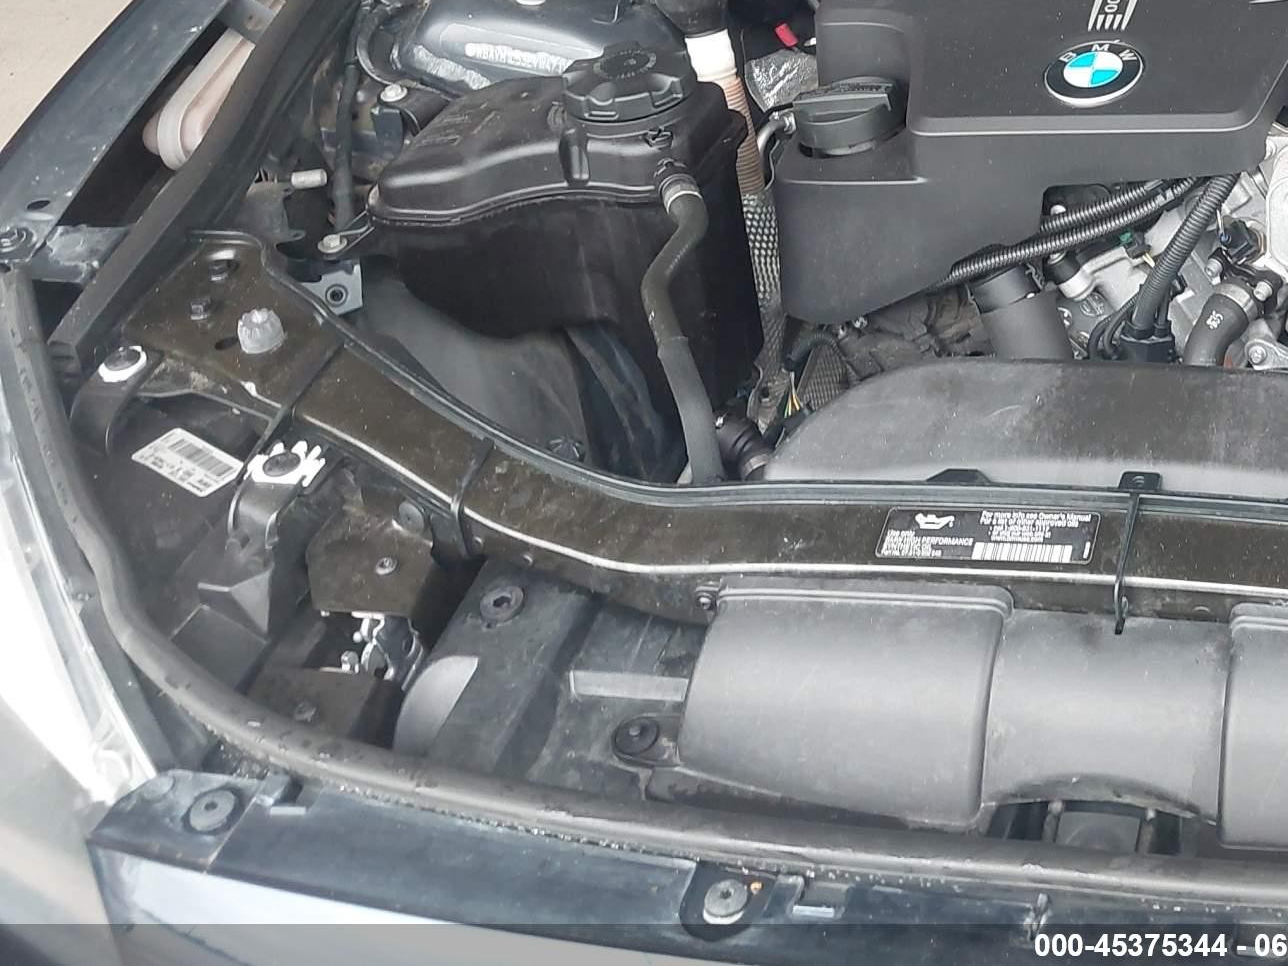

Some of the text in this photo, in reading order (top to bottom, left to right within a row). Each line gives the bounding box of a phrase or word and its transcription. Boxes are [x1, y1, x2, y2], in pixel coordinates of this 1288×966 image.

[1058, 43, 1138, 63] BMW
[1039, 512, 1066, 521] Owner's
[1067, 513, 1091, 522] Manual
[922, 537, 974, 546] PERFORMANCE
